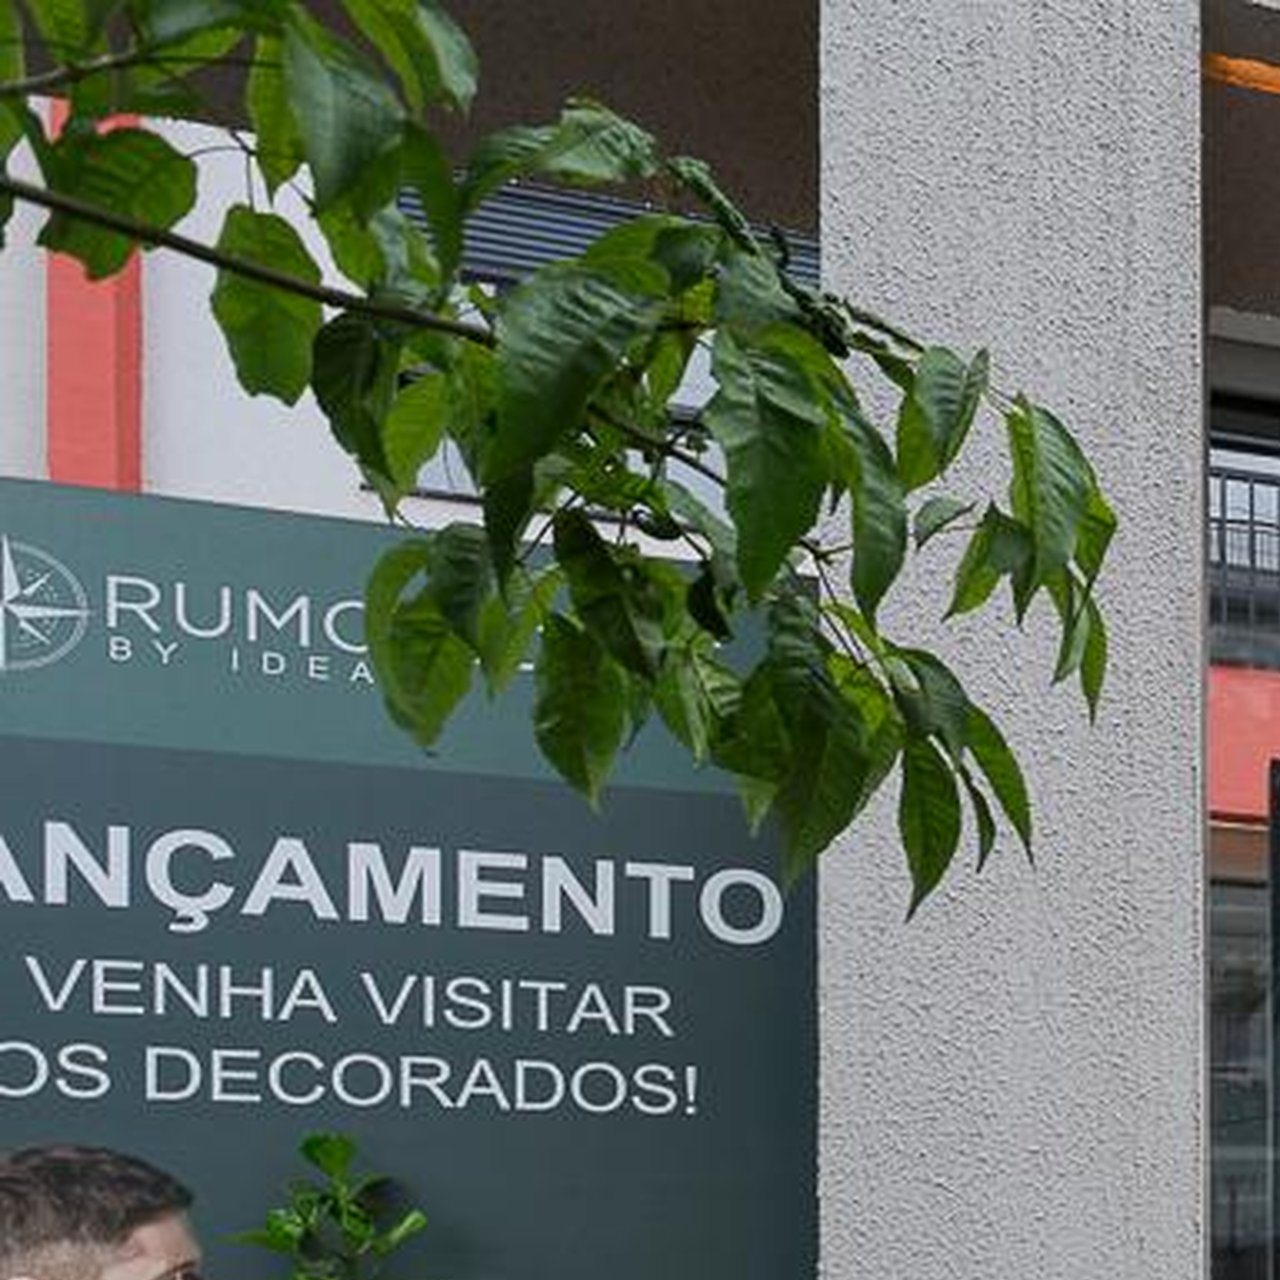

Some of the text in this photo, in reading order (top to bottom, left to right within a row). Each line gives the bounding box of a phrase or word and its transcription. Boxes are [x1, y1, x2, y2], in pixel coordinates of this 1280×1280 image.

[108, 636, 180, 664] BY
[25, 955, 675, 1038] VENHA VISITAR
[144, 1046, 699, 1117] DECORADOS!
